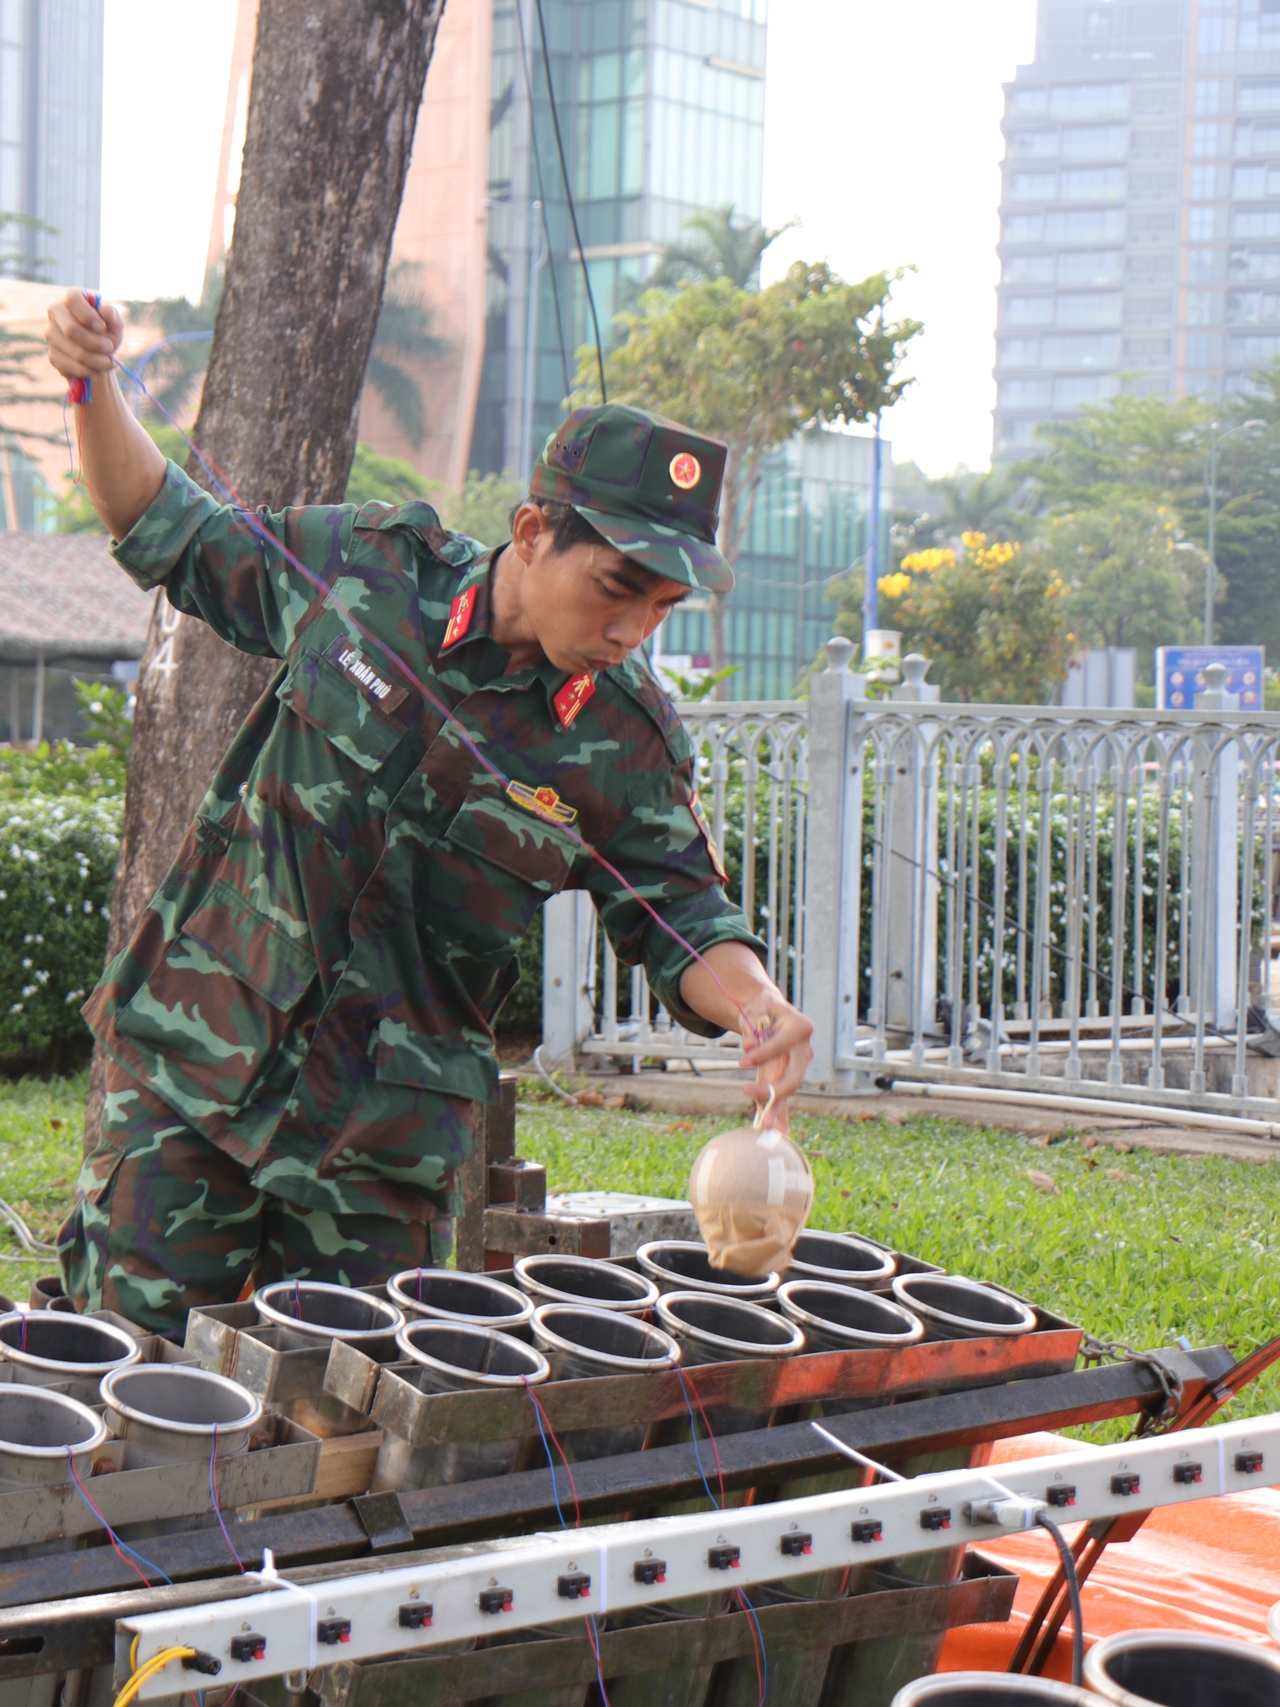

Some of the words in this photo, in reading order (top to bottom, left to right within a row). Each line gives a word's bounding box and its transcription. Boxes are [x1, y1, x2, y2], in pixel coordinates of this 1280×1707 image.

[337, 649, 355, 667] LÊ
[348, 659, 376, 686] XUÂN
[368, 677, 393, 699] PHÚ
